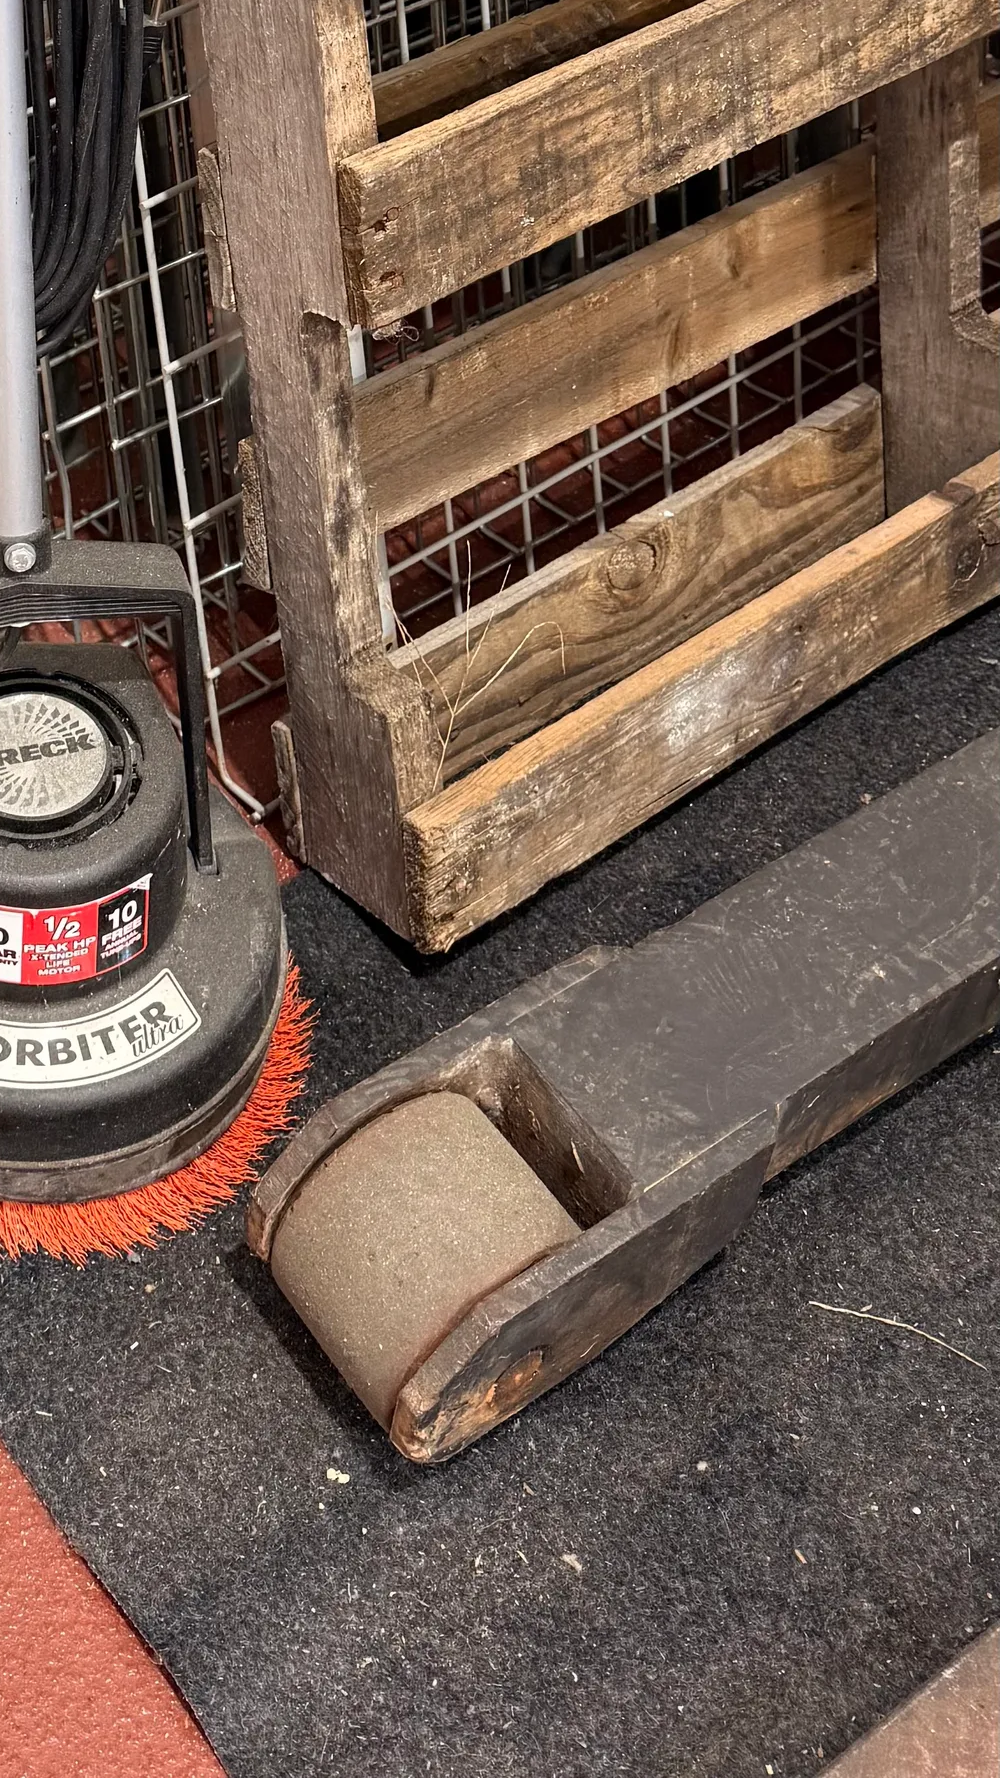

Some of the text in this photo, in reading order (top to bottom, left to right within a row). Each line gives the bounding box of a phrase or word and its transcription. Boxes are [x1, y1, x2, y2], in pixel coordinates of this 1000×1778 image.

[109, 900, 137, 930] 10
[43, 916, 80, 941] 1/2
[102, 915, 142, 946] FREE
[23, 936, 97, 954] PEAK HP
[30, 948, 89, 962] X-TENDED
[38, 965, 81, 976] MOTOR
[45, 959, 71, 968] LIFE
[130, 1015, 183, 1059] ultra
